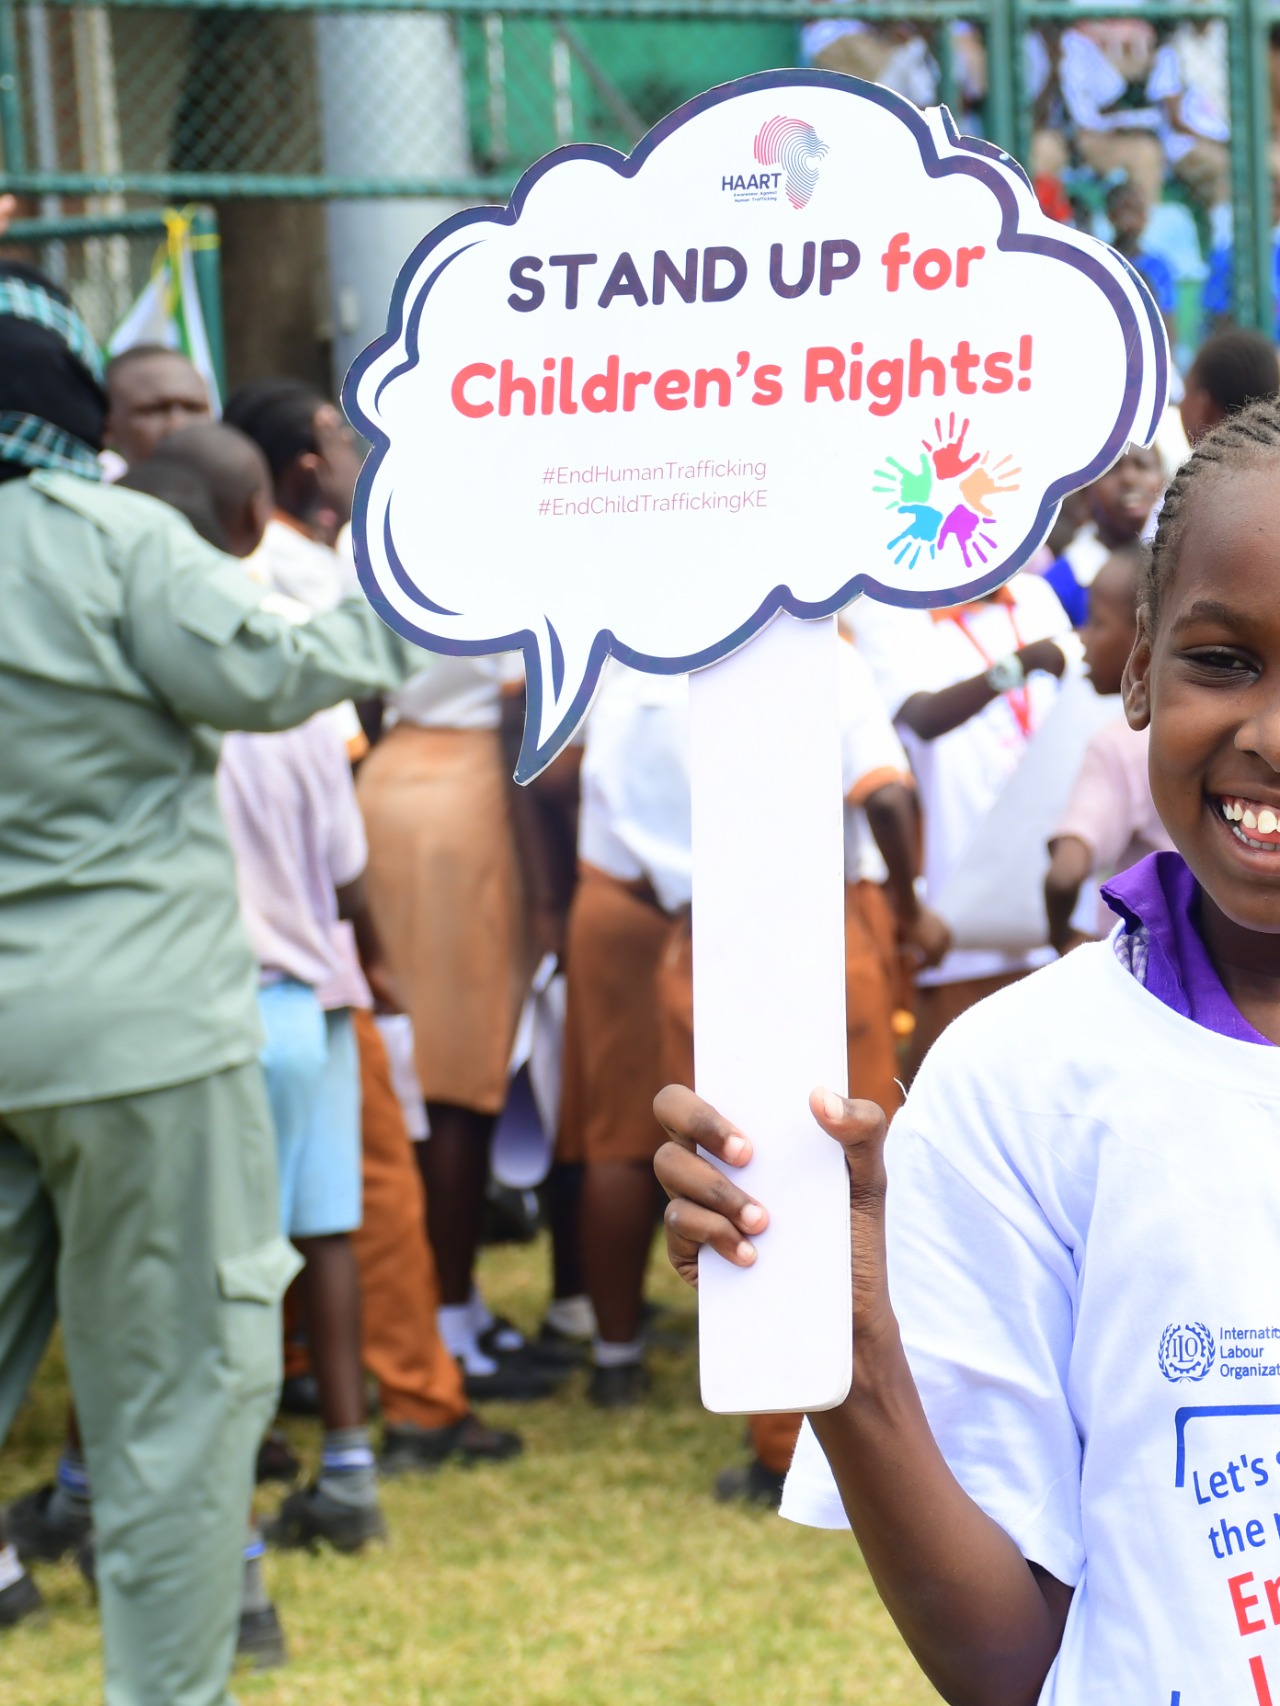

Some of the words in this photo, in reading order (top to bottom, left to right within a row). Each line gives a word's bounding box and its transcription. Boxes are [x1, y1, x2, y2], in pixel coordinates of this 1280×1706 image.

[721, 173, 782, 191] HAART
[506, 245, 748, 313] STAND
[768, 238, 861, 299] UP
[880, 231, 985, 293] for
[804, 334, 1033, 416] Rights!
[541, 457, 767, 484] #EndHumanTrafficking
[538, 489, 768, 516] #EndChildTraffickingKE
[1172, 1334, 1199, 1363] ILO
[1219, 1344, 1265, 1360] Labour
[1192, 1455, 1269, 1506] Let's
[1208, 1518, 1266, 1559] the
